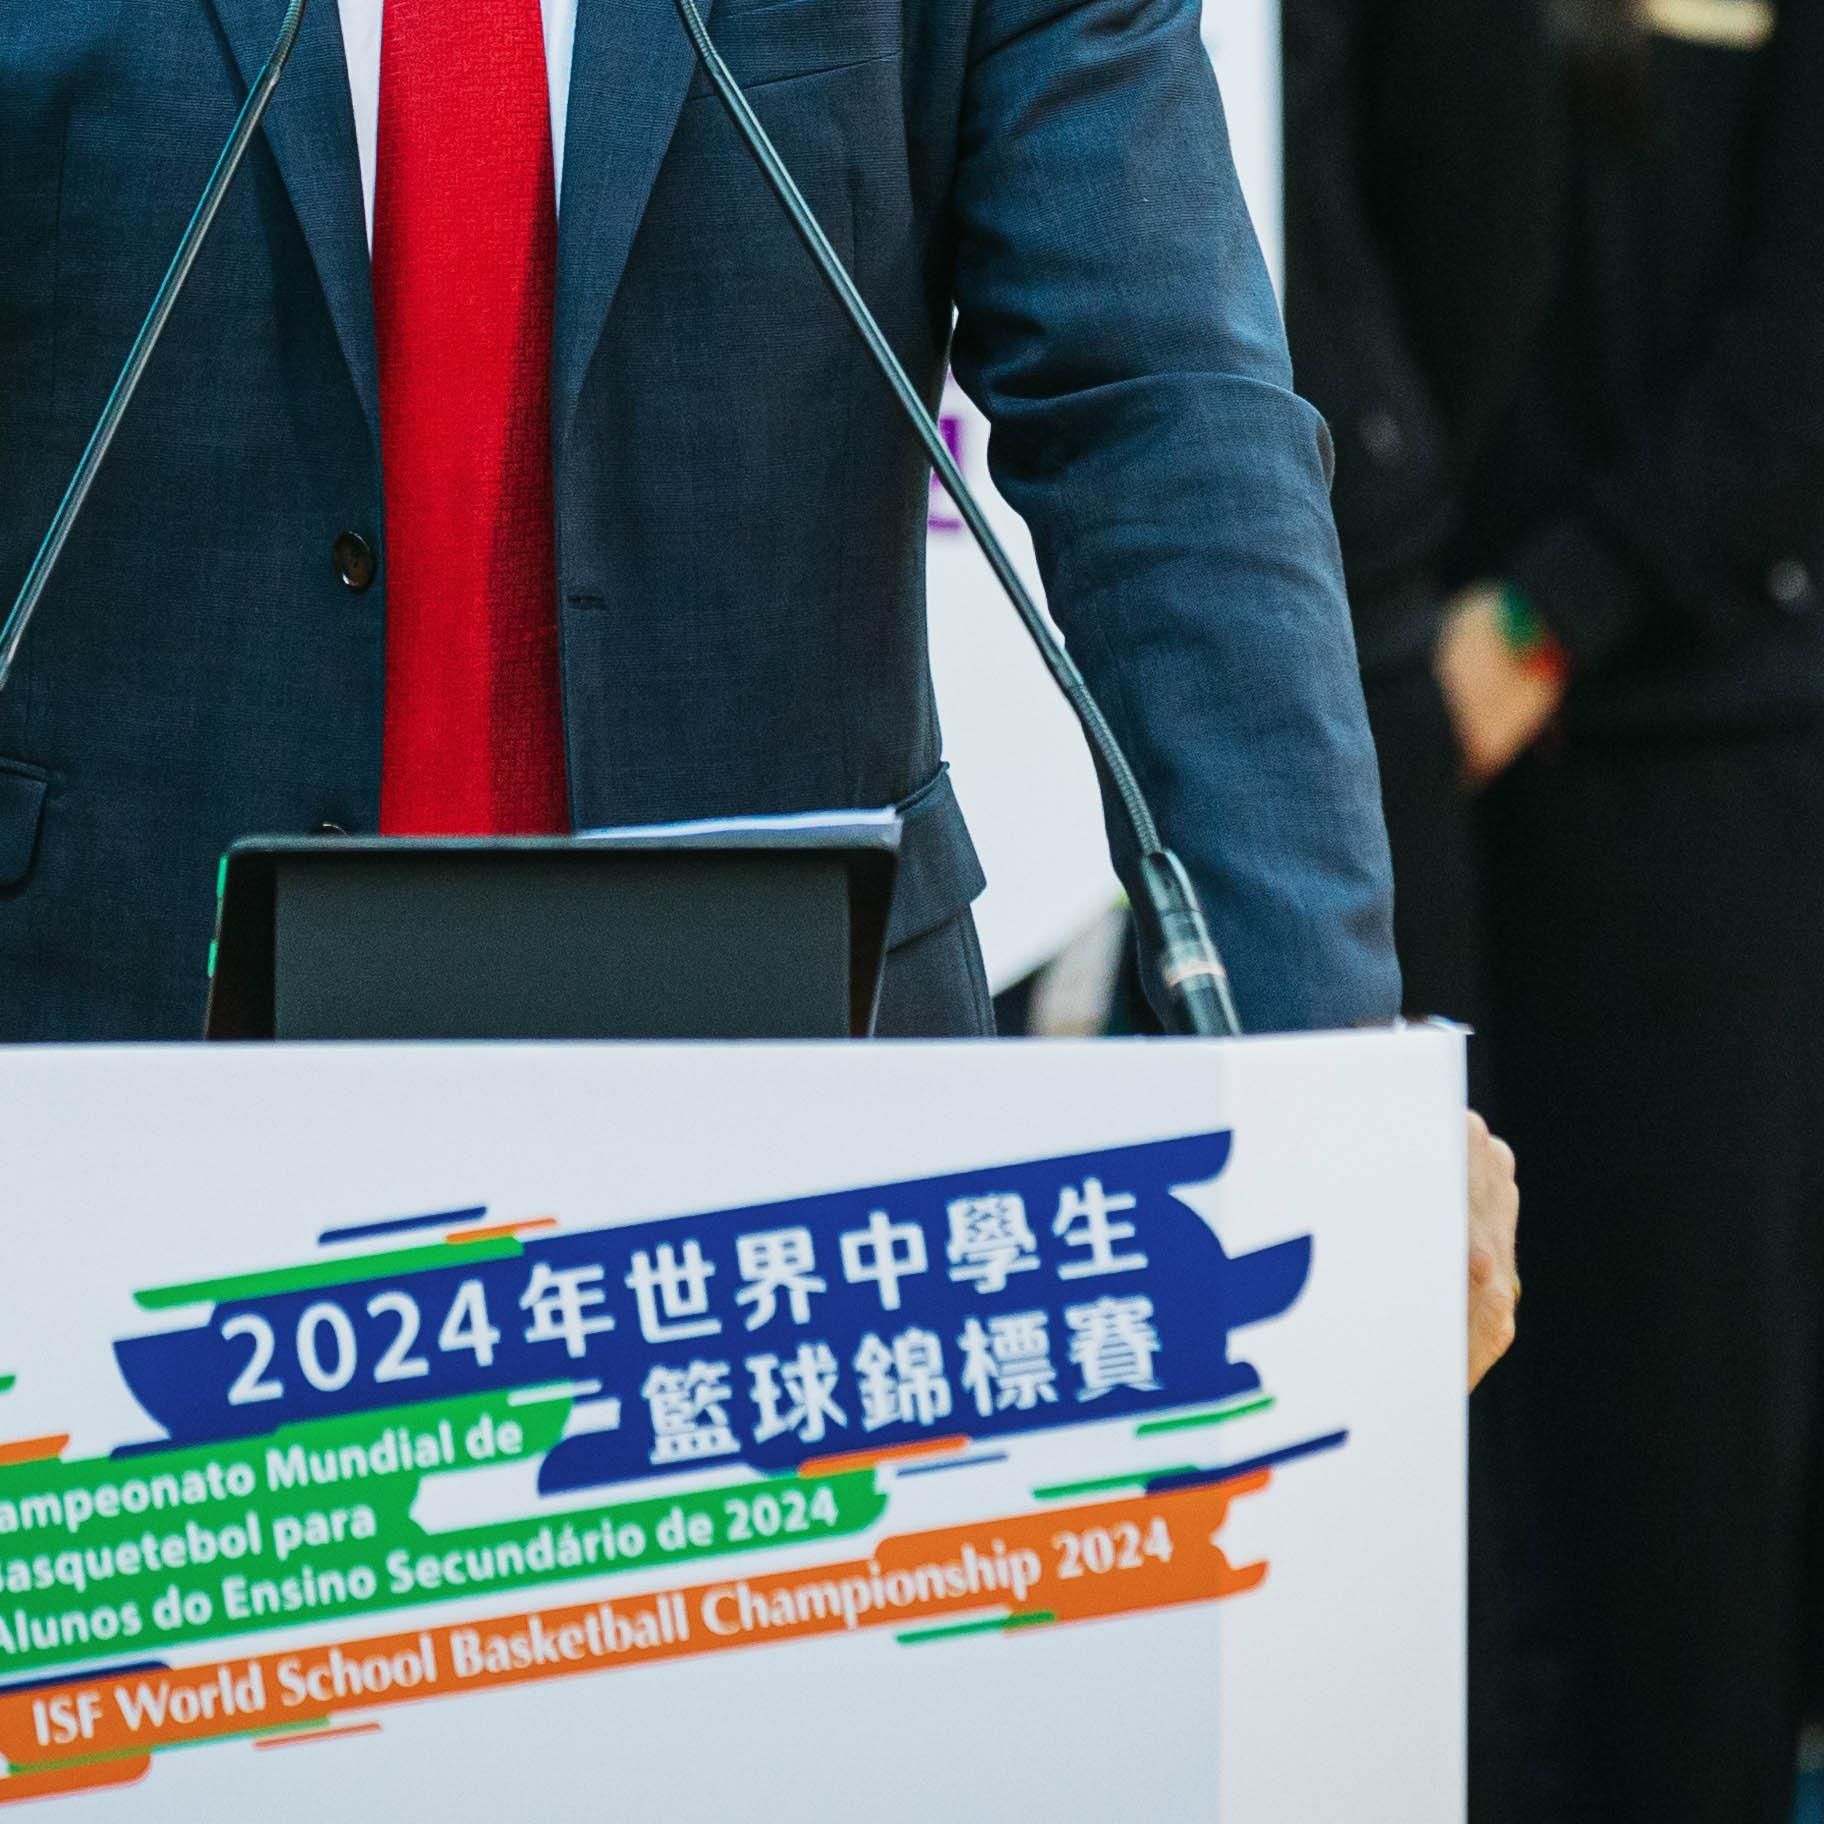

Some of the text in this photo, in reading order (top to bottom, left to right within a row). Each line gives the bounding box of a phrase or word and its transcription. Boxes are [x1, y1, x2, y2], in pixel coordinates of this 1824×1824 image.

[222, 1182, 1148, 1404] 2024年世界中學生
[267, 1420, 455, 1489] Mundial
[464, 1414, 524, 1456] de
[644, 1295, 1162, 1464] 籃球錦標賽
[152, 1584, 212, 1632] do
[222, 1562, 376, 1622] Ensino
[386, 1527, 645, 1595] Secundário
[656, 1508, 714, 1548] de
[724, 1486, 840, 1542] 2024
[276, 1504, 375, 1560] para
[32, 1514, 1176, 1748] ISF World School Basketball Championship 2024
